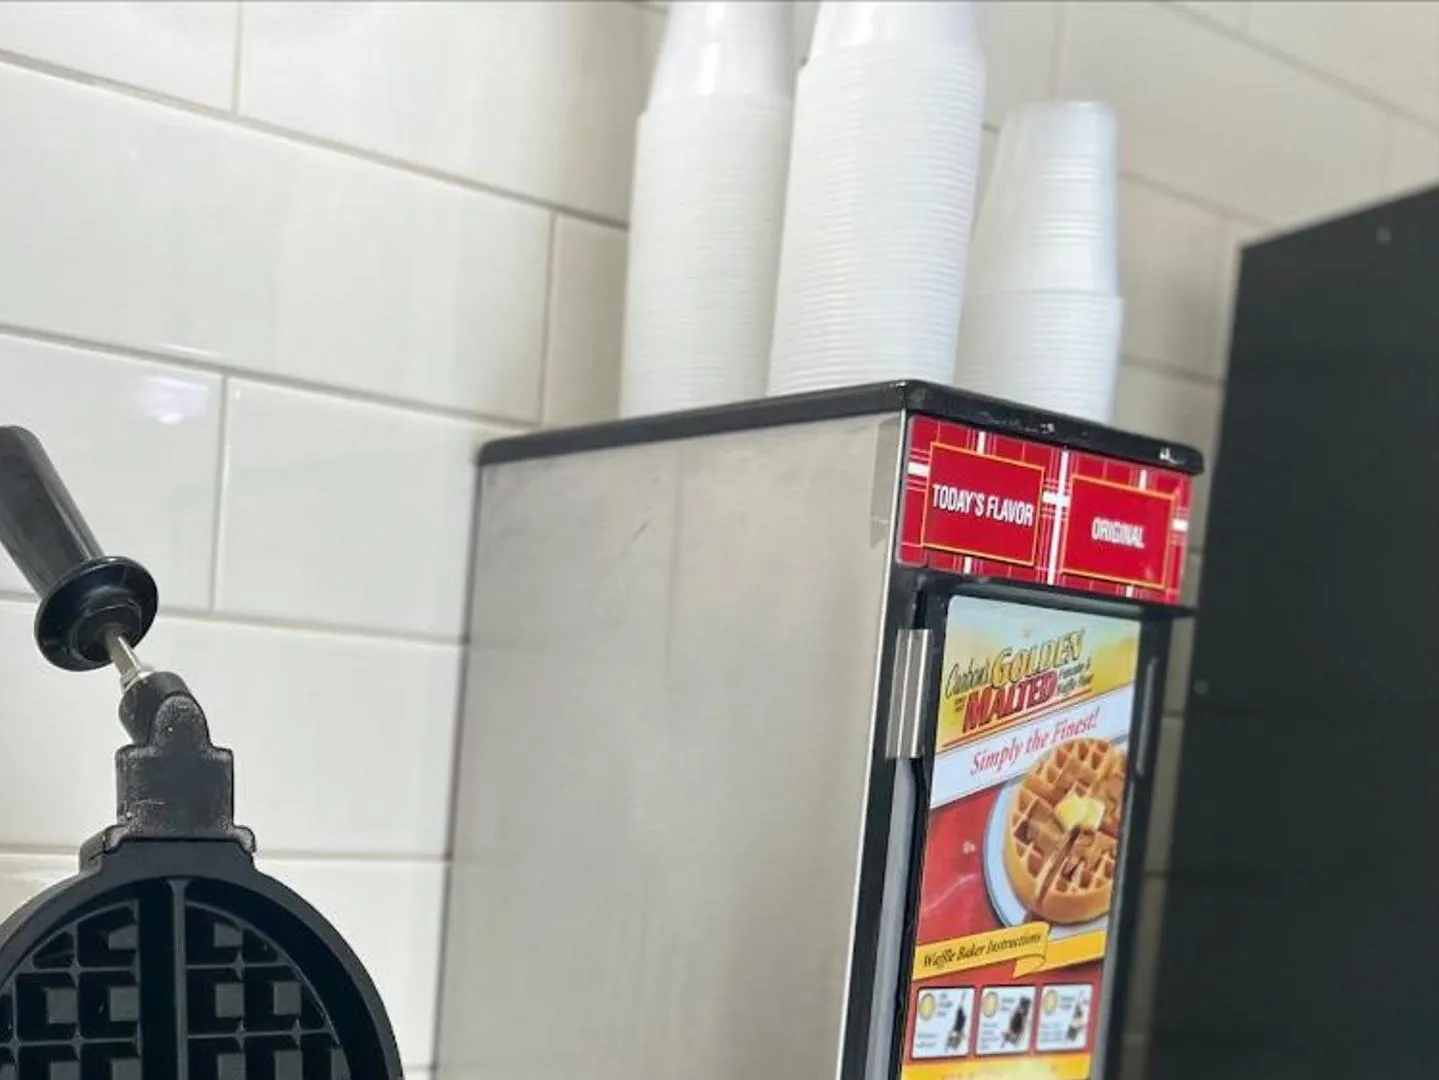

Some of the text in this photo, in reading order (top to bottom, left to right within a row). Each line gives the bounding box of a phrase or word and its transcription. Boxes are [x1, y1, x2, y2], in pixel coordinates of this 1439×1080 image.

[932, 483, 1034, 527] TODAY'S FLAVOR
[1091, 516, 1145, 549] ORIGINAL
[990, 628, 1086, 690] GOLDEN
[962, 669, 1059, 734] MALTED
[970, 706, 1101, 776] Simply the Finest!
